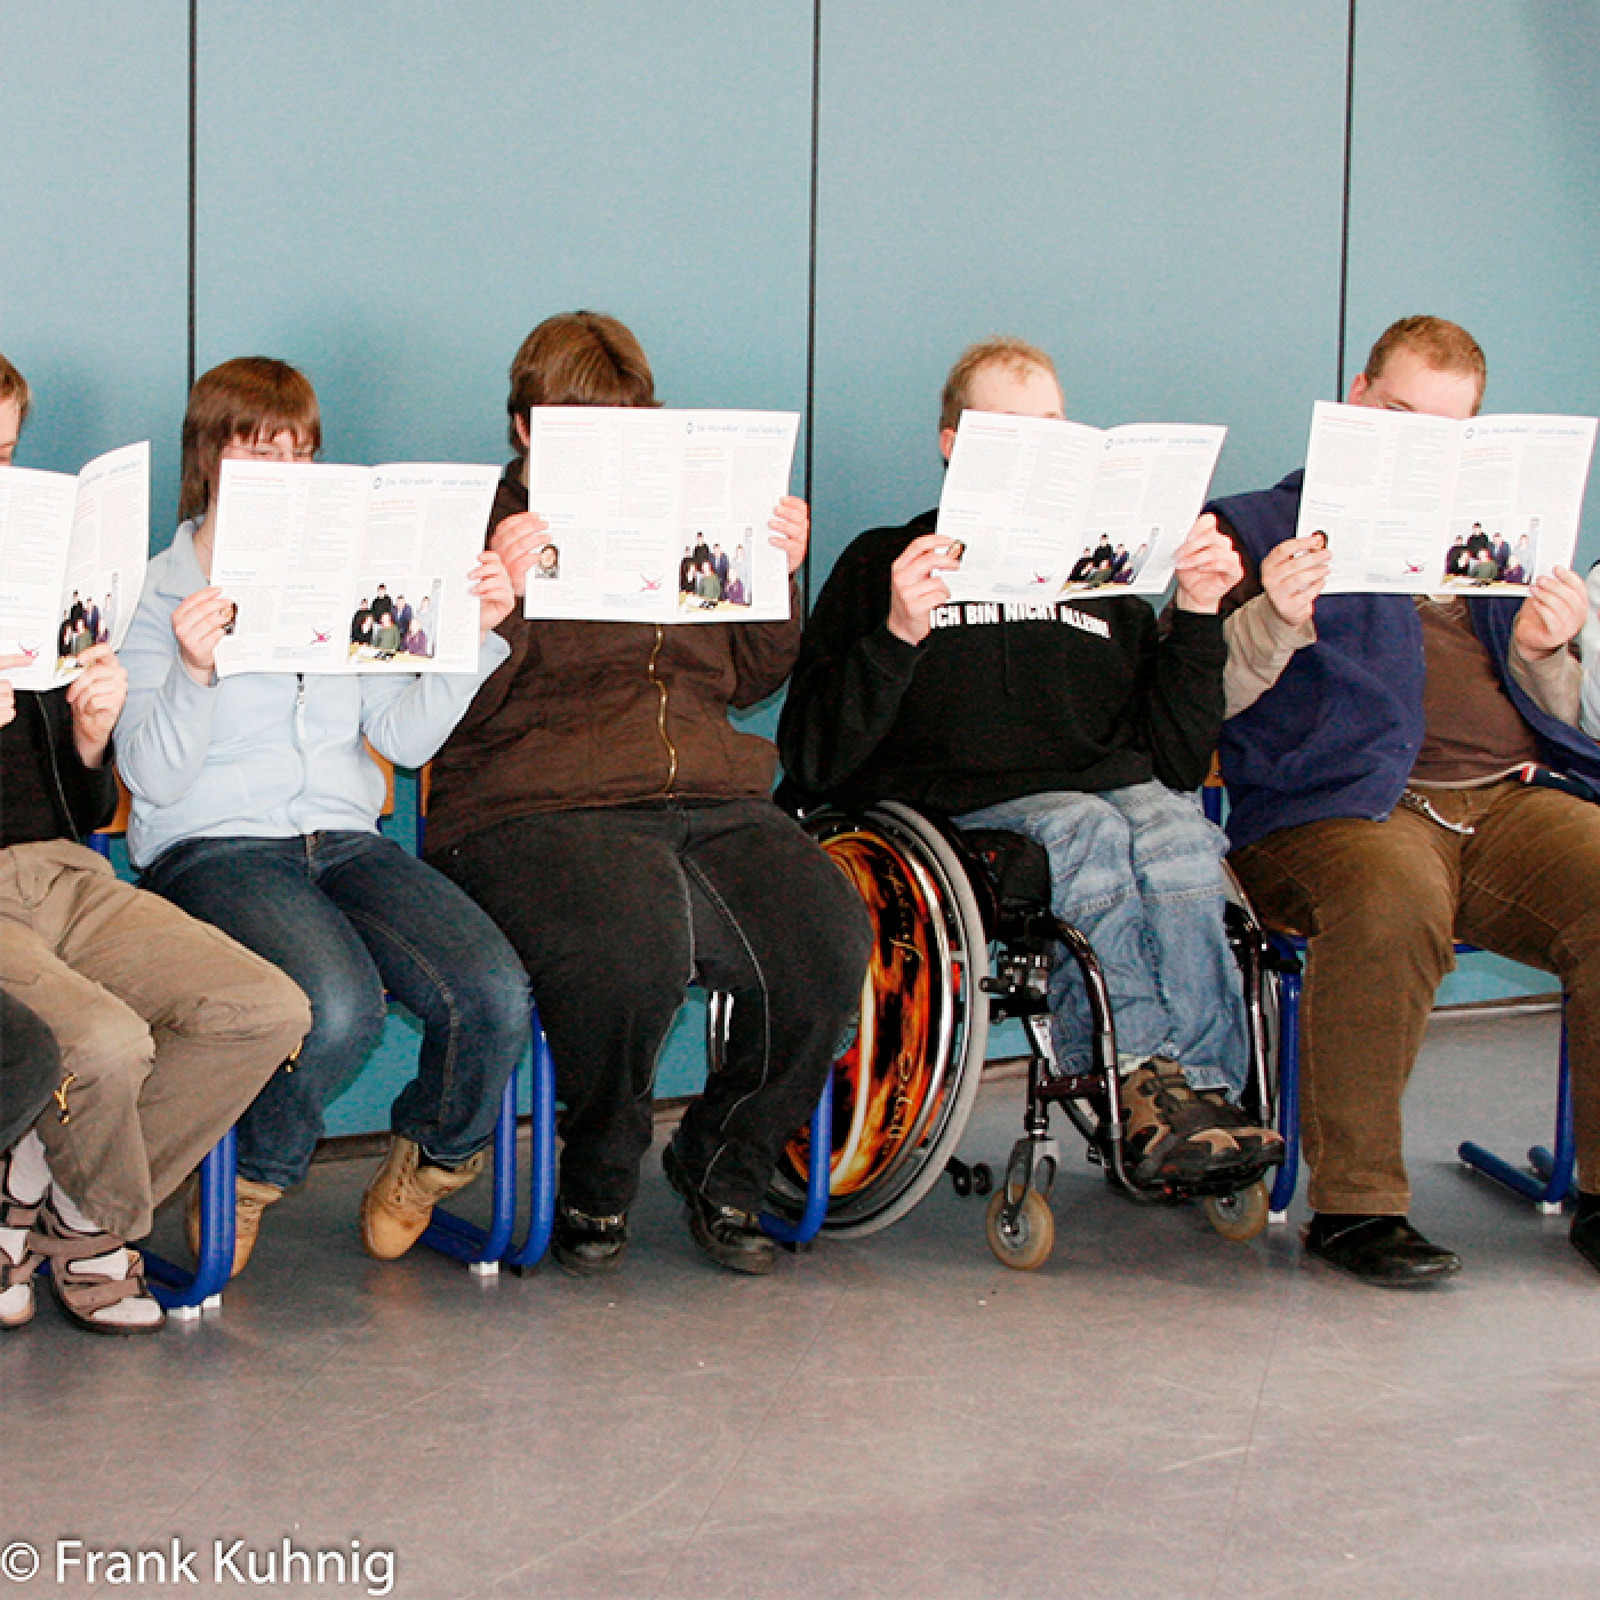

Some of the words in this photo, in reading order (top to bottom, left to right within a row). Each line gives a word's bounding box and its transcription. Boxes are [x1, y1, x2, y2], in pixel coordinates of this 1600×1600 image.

[930, 605, 961, 629] ICH
[966, 602, 1000, 624] BIN
[1005, 602, 1057, 620] NICHT
